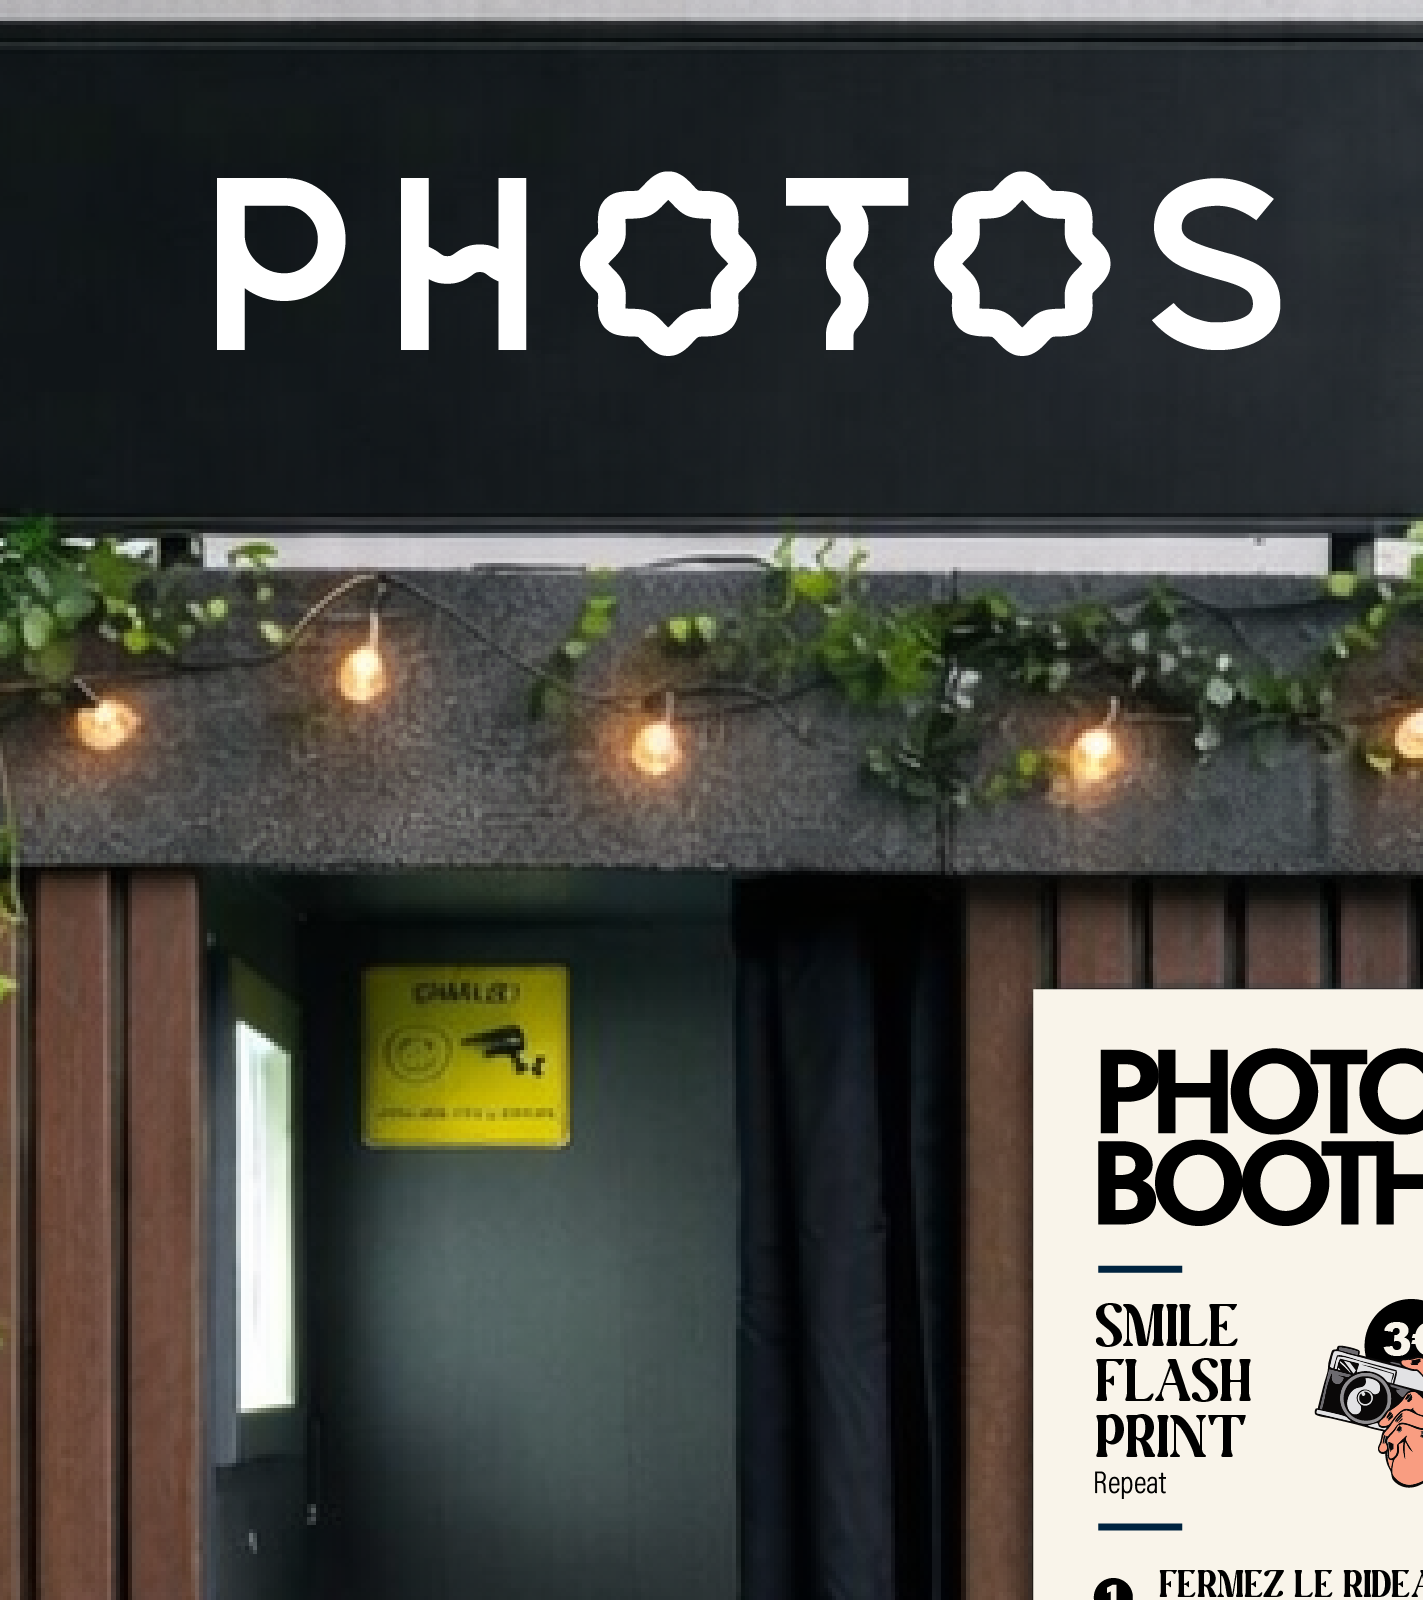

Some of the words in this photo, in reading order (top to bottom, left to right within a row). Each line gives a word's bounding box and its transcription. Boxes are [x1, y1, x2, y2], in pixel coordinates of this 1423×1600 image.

[217, 171, 1280, 356] PHOTOS
[1096, 1303, 1238, 1347] SMILE
[1096, 1358, 1251, 1402] FLASH
[1096, 1414, 1246, 1457] PRINT
[1095, 1471, 1166, 1499] Repeat
[1160, 1570, 1284, 1597] FERMEZ
[1295, 1570, 1332, 1597] LE
